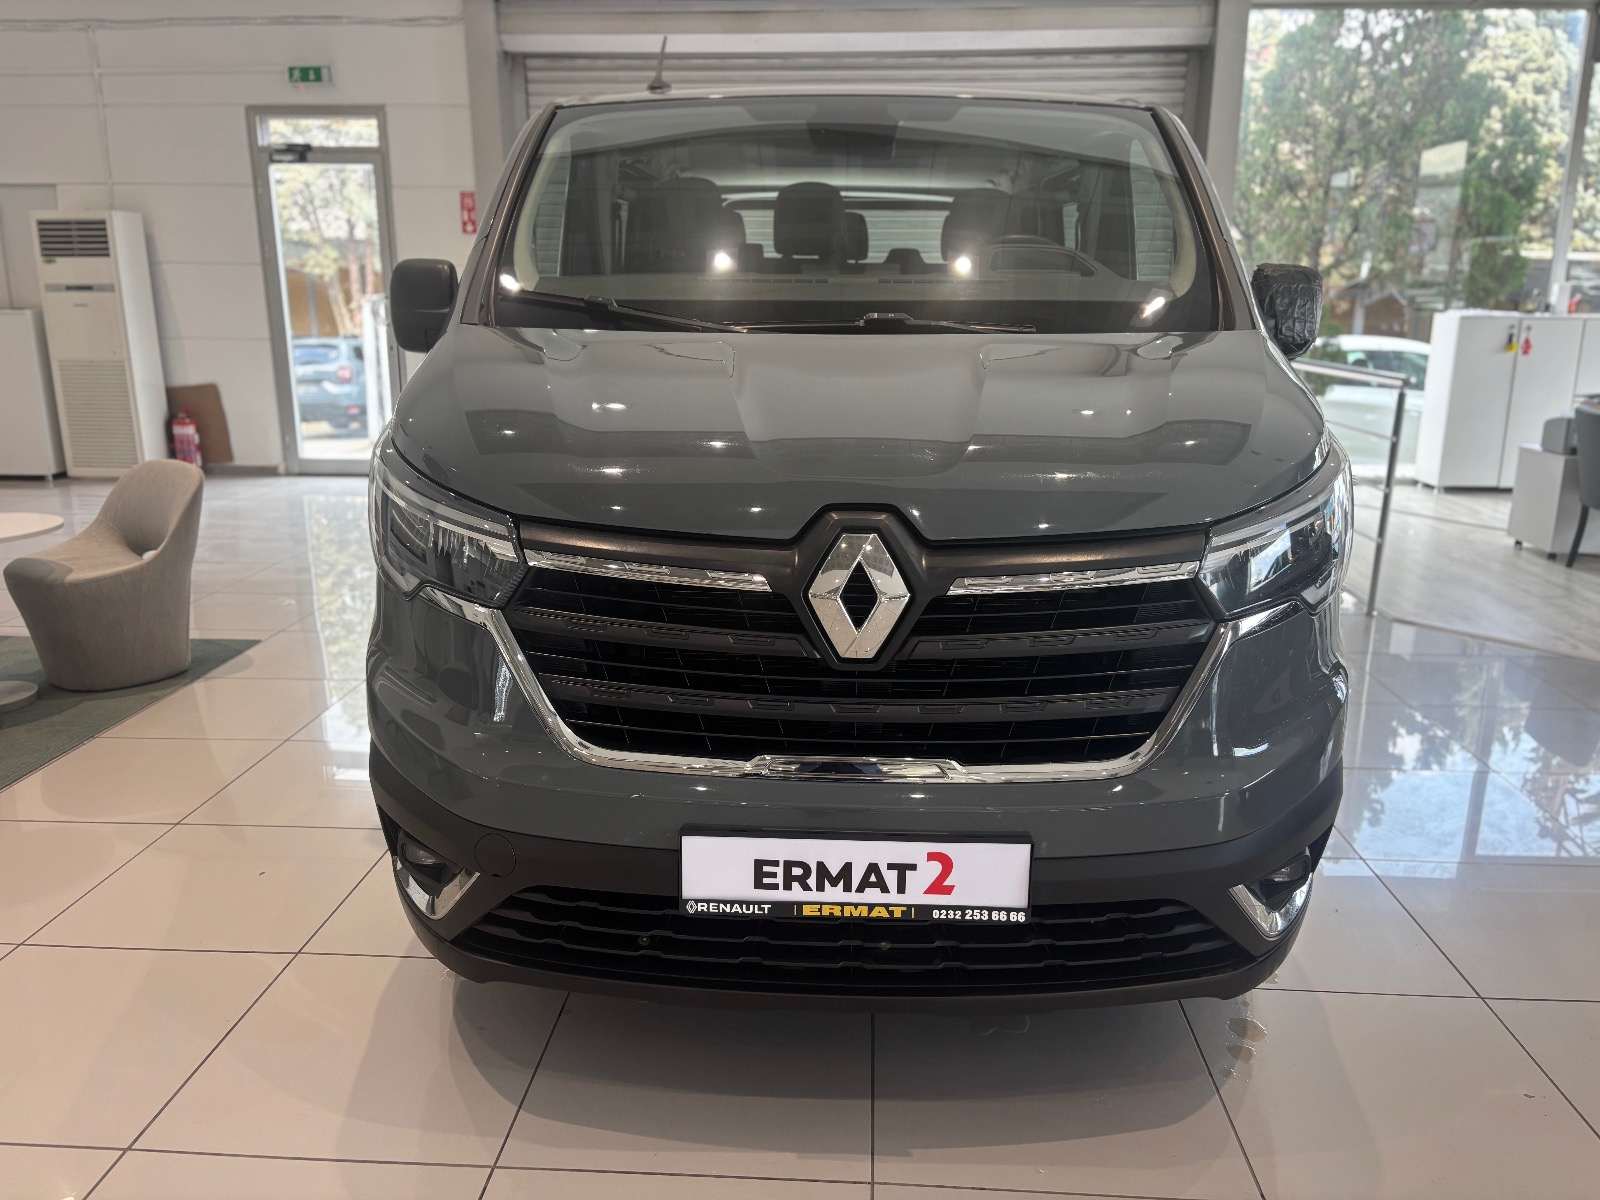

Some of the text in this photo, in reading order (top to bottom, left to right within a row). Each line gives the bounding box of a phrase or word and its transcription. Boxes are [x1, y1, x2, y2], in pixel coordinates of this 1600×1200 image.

[754, 852, 956, 896] ERMAT 2
[697, 902, 772, 914] RENAULT
[802, 904, 907, 918] ERMAT
[932, 909, 962, 920] 0232
[964, 909, 989, 921] 253
